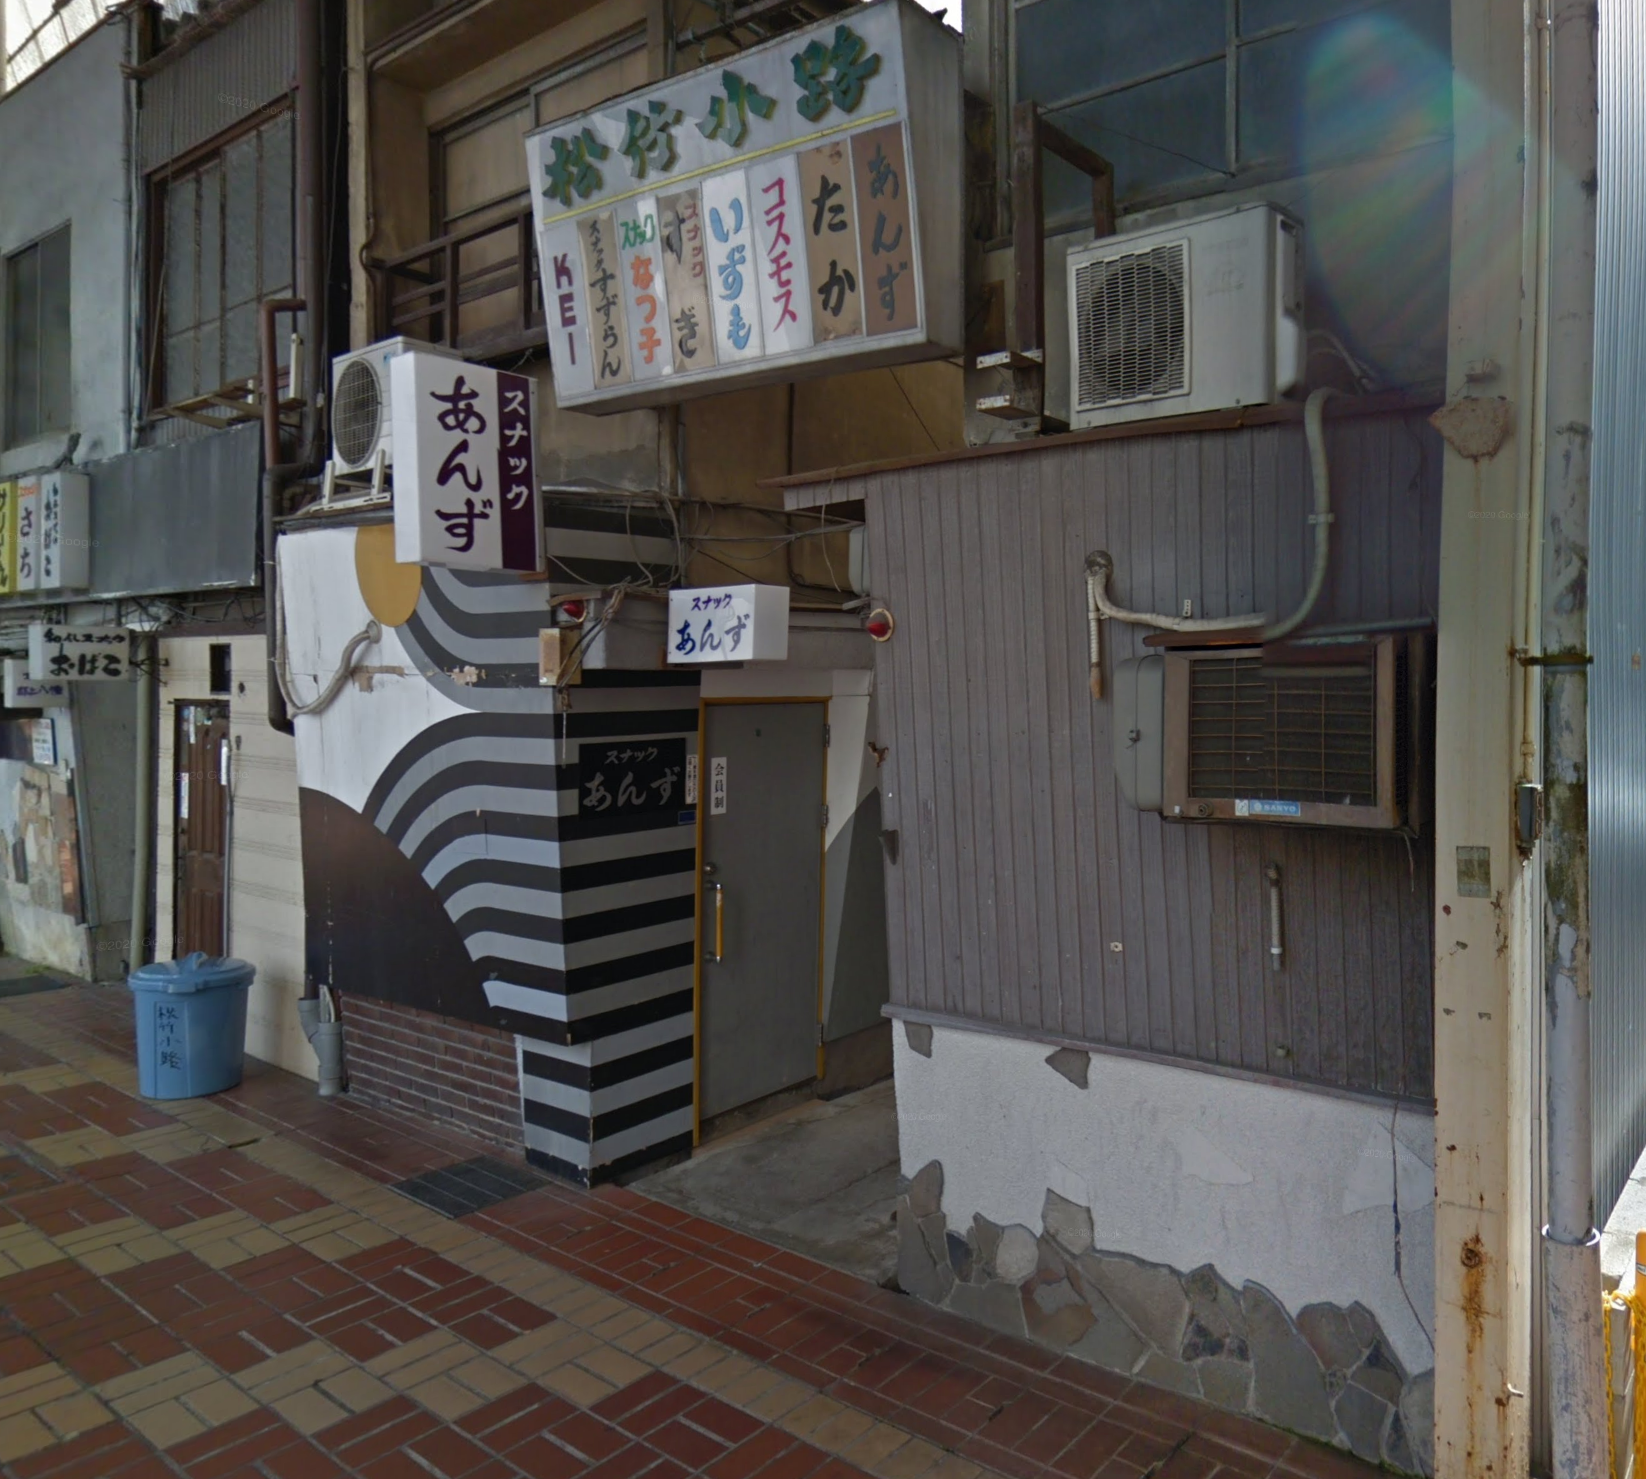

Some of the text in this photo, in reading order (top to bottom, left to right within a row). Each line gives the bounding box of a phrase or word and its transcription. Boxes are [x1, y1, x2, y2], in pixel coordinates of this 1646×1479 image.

[541, 24, 881, 207] 松竹小路
[709, 197, 751, 351] いずも
[761, 177, 797, 333] コスモス
[811, 175, 856, 318] たか
[867, 142, 908, 322] あんず
[630, 255, 662, 365] なつ子
[430, 375, 494, 553] あんず
[503, 390, 529, 510] スナック
[675, 613, 750, 655] あんず
[691, 593, 733, 612] スナック
[582, 766, 681, 811] あんず
[603, 746, 658, 765] スナック
[714, 763, 725, 809] 会員制
